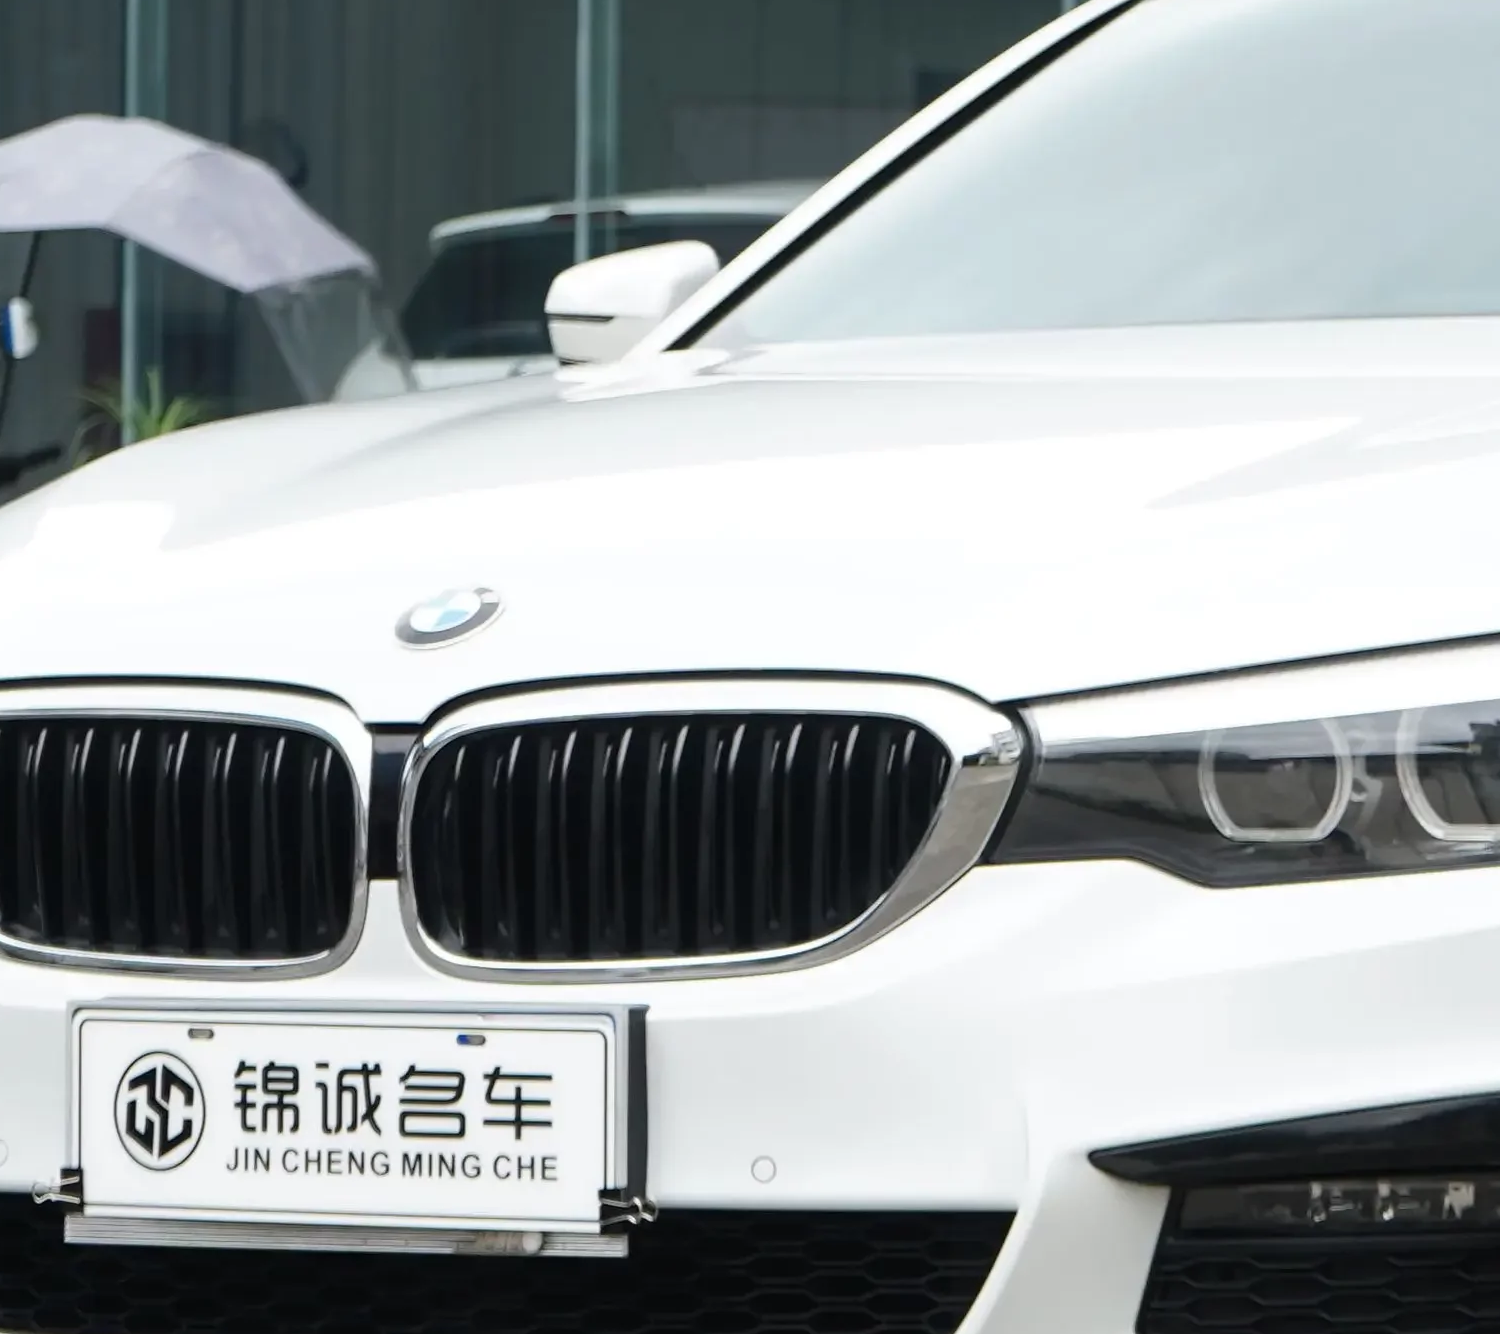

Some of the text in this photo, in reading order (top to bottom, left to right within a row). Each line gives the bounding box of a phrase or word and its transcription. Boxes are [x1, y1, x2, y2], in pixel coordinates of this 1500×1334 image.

[232, 1059, 554, 1142] 锦诚名车
[225, 1146, 557, 1182] JIN CHENG MING CHE
